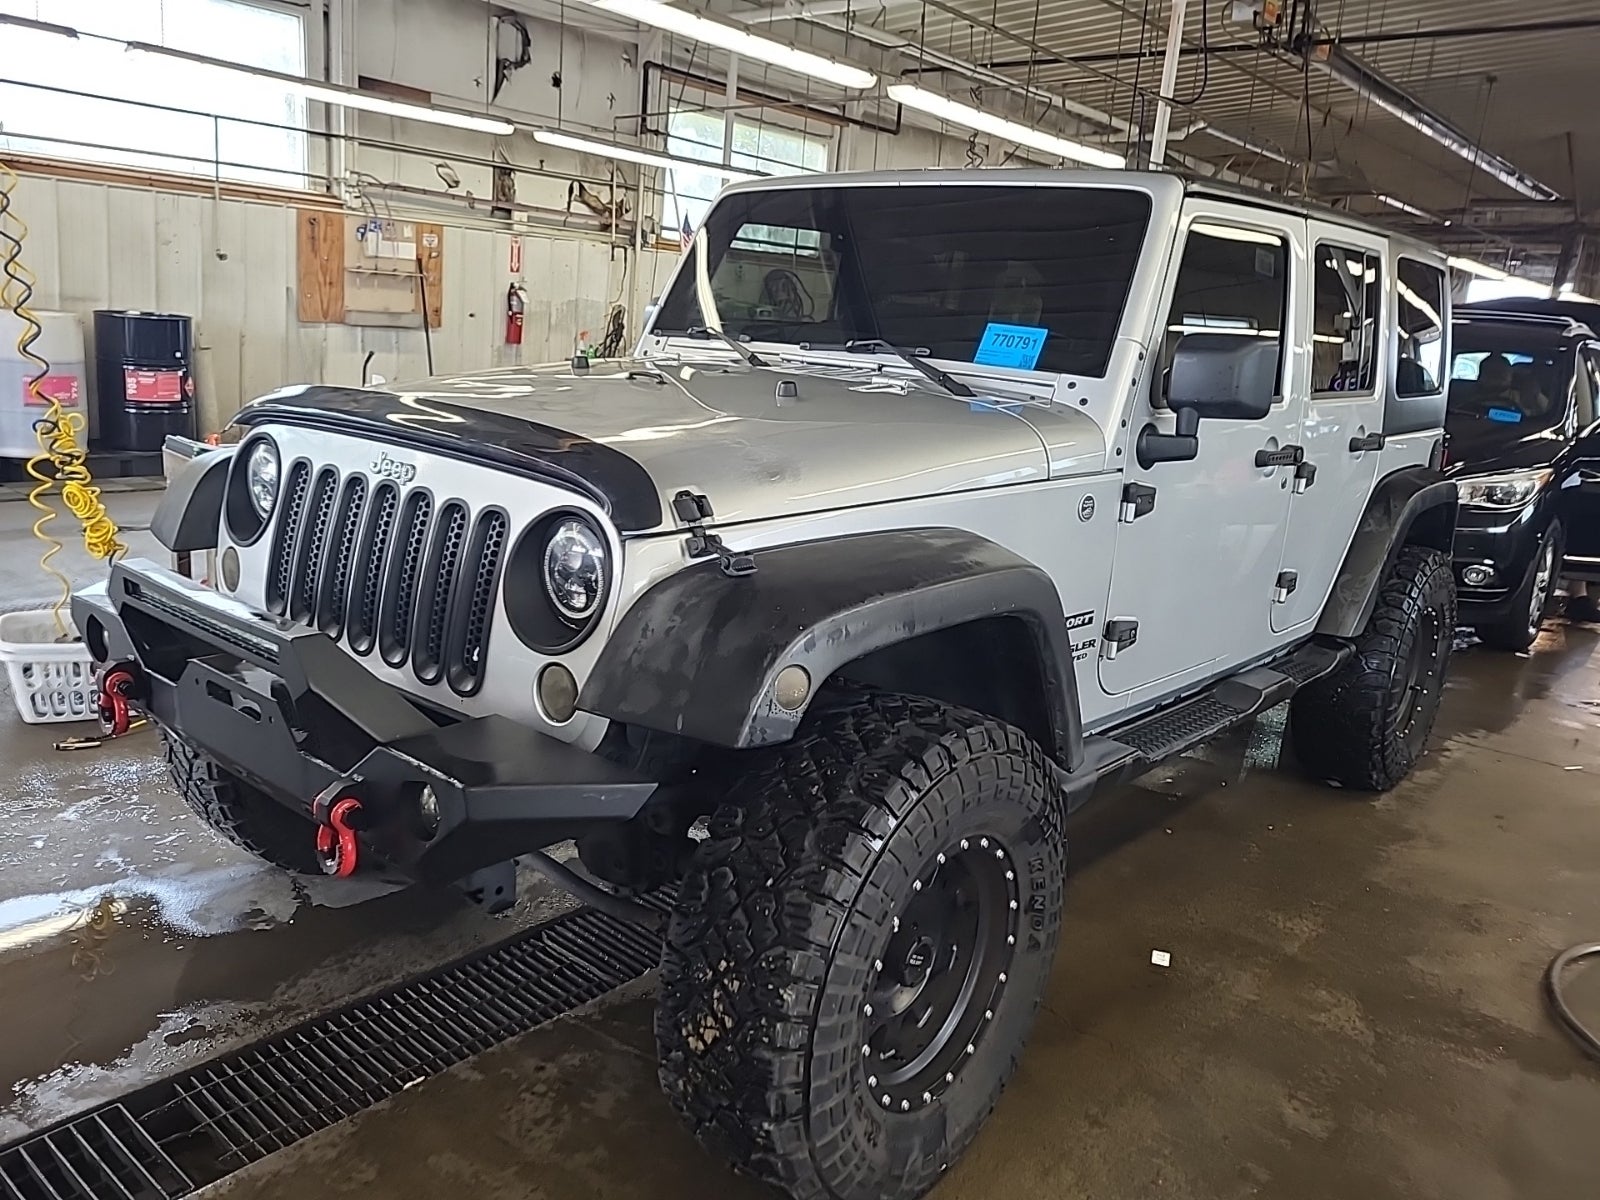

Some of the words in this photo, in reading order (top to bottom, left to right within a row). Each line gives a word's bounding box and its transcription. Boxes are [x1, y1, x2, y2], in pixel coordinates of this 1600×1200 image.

[991, 333, 1038, 351] 770791
[370, 451, 416, 485] Jeep
[1065, 614, 1094, 628] ORT
[1027, 858, 1046, 952] KENDA
